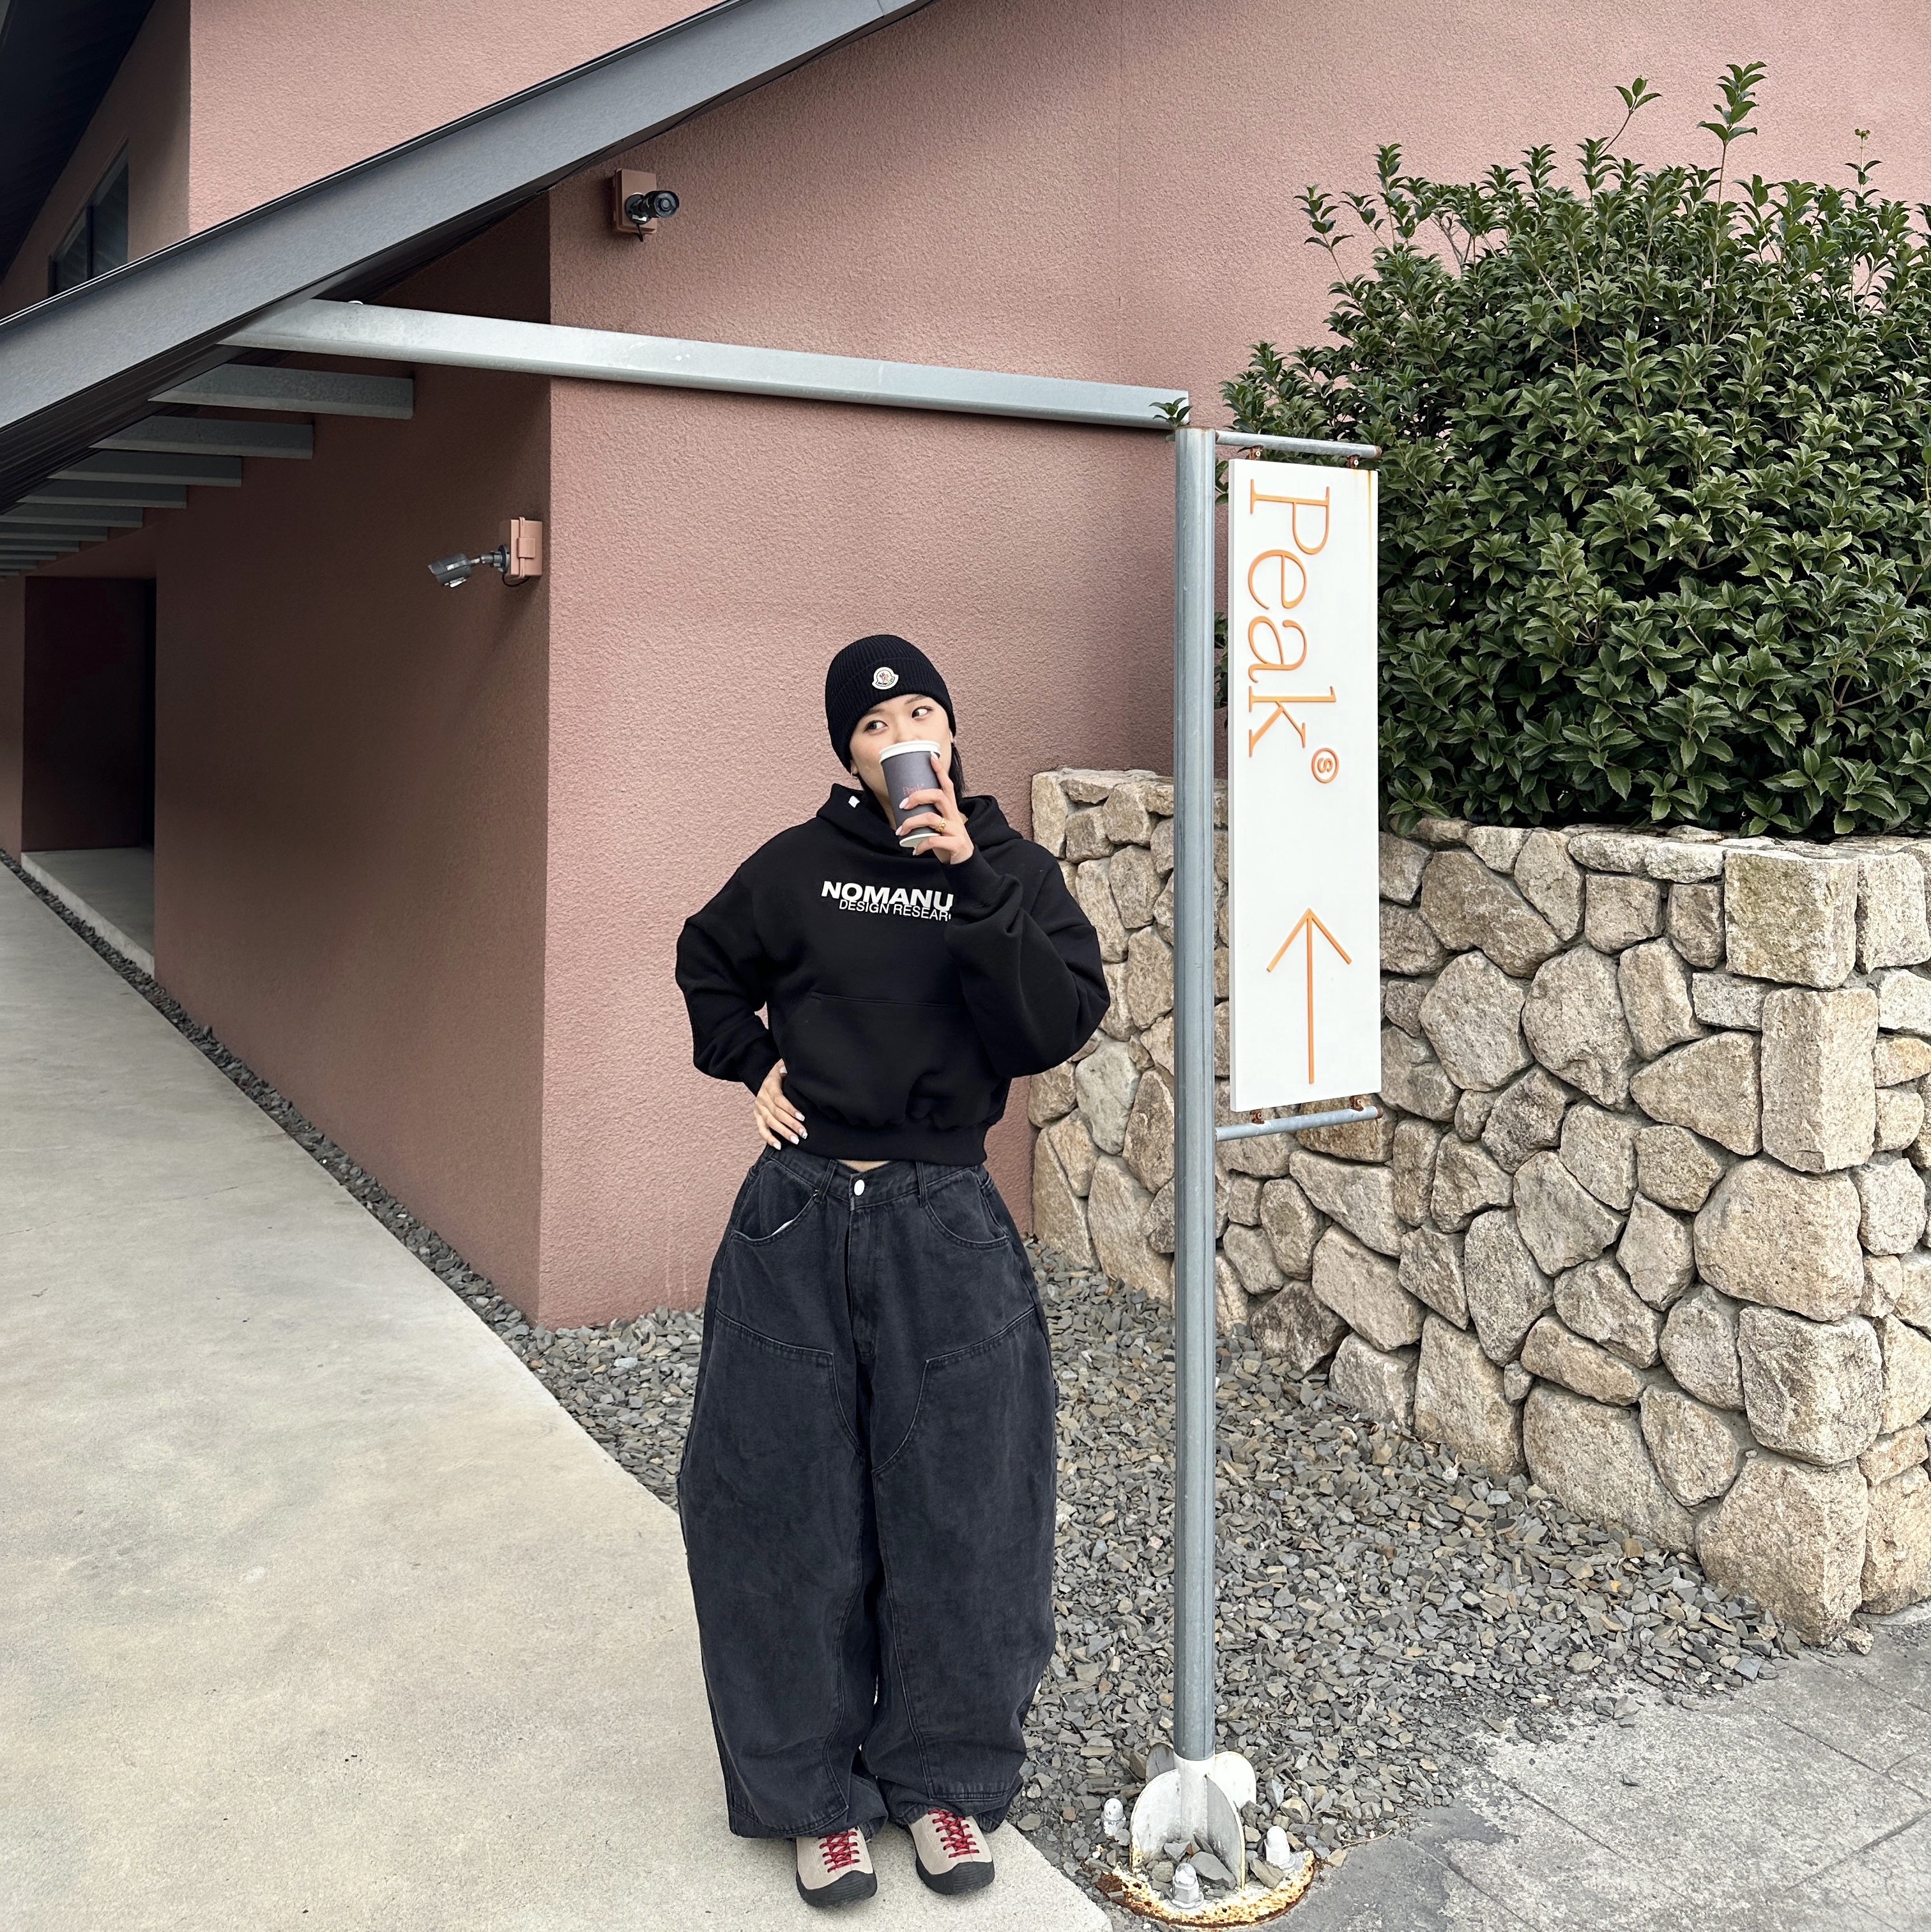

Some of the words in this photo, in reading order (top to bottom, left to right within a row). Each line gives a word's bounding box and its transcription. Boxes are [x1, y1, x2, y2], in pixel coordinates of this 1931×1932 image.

[1247, 479, 1337, 758] Peak
[821, 880, 954, 912] NOMANU
[839, 898, 890, 914] DESIGN
[893, 903, 952, 921] RESEAR
